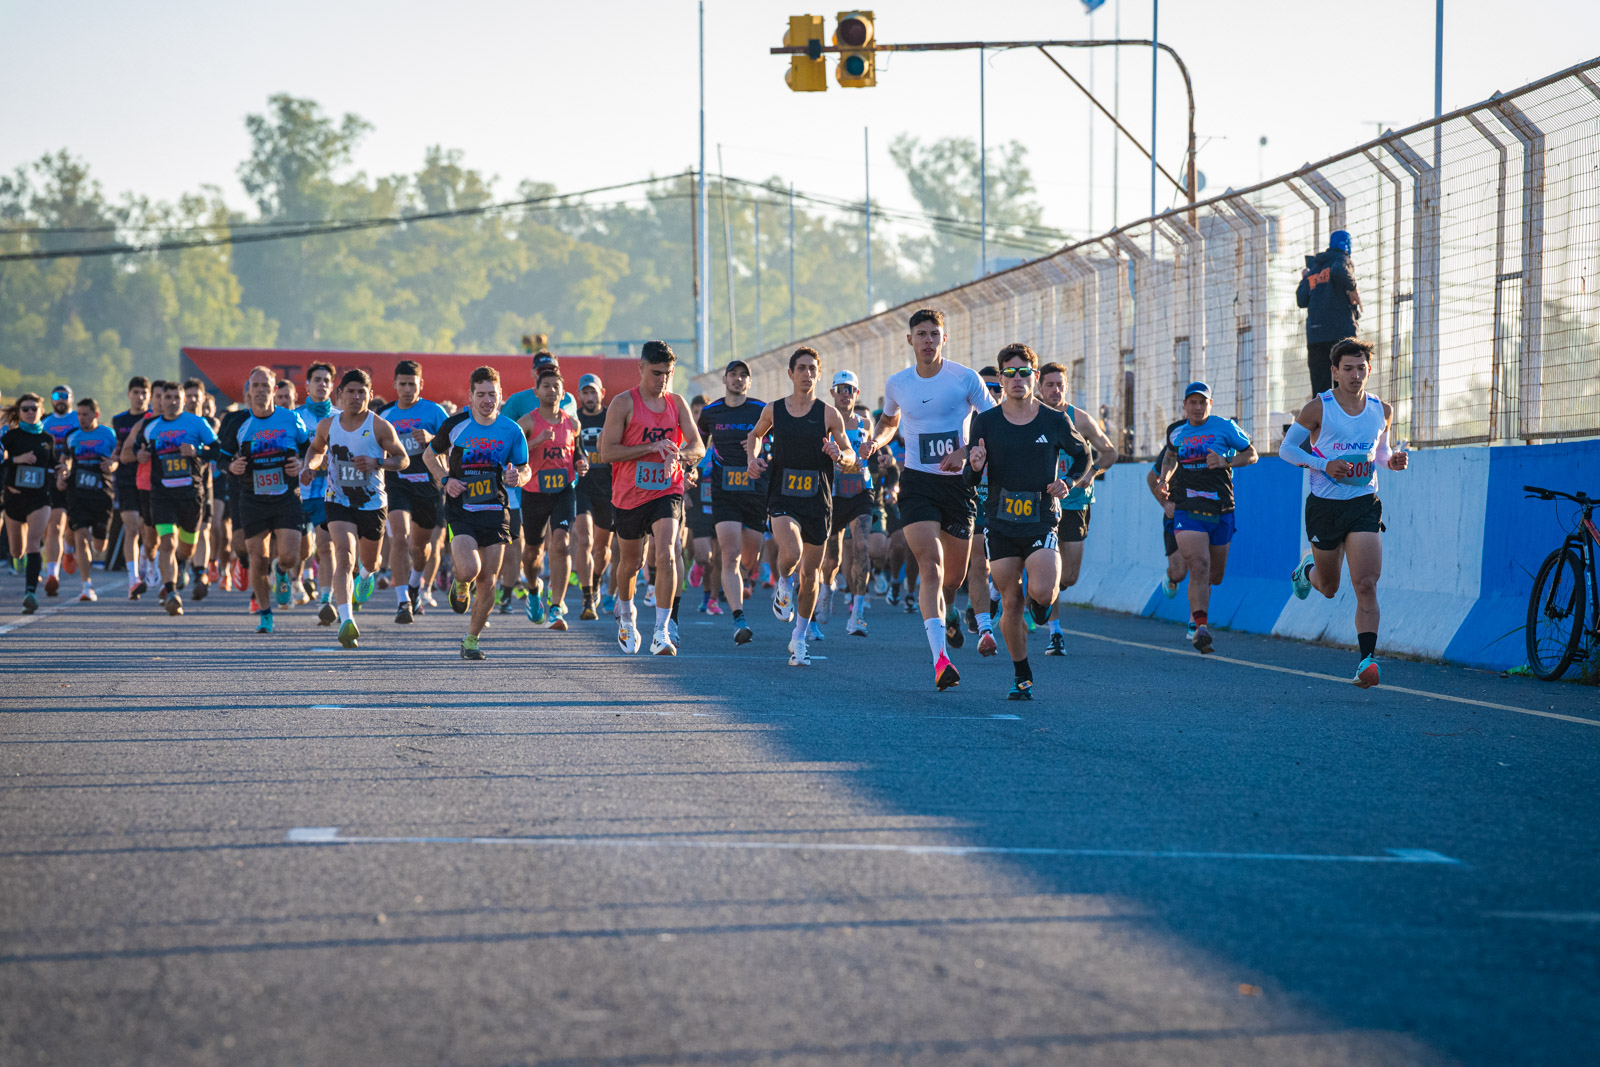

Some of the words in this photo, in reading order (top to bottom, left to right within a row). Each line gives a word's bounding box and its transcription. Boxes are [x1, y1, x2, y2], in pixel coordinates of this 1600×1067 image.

[715, 423, 755, 431] RUNNEA
[641, 427, 673, 443] KRC
[400, 437, 419, 451] 05
[928, 438, 954, 457] 106
[1332, 442, 1374, 451] RUNNEA
[166, 458, 187, 472] 756
[1346, 460, 1369, 478] 303
[23, 471, 37, 484] 21
[258, 472, 279, 487] 359
[341, 465, 364, 481] 174
[642, 467, 665, 484] 313
[727, 471, 749, 486] 782
[467, 479, 492, 498] 707
[544, 474, 565, 489] 712
[788, 474, 812, 491] 718
[1005, 497, 1033, 517] 706
